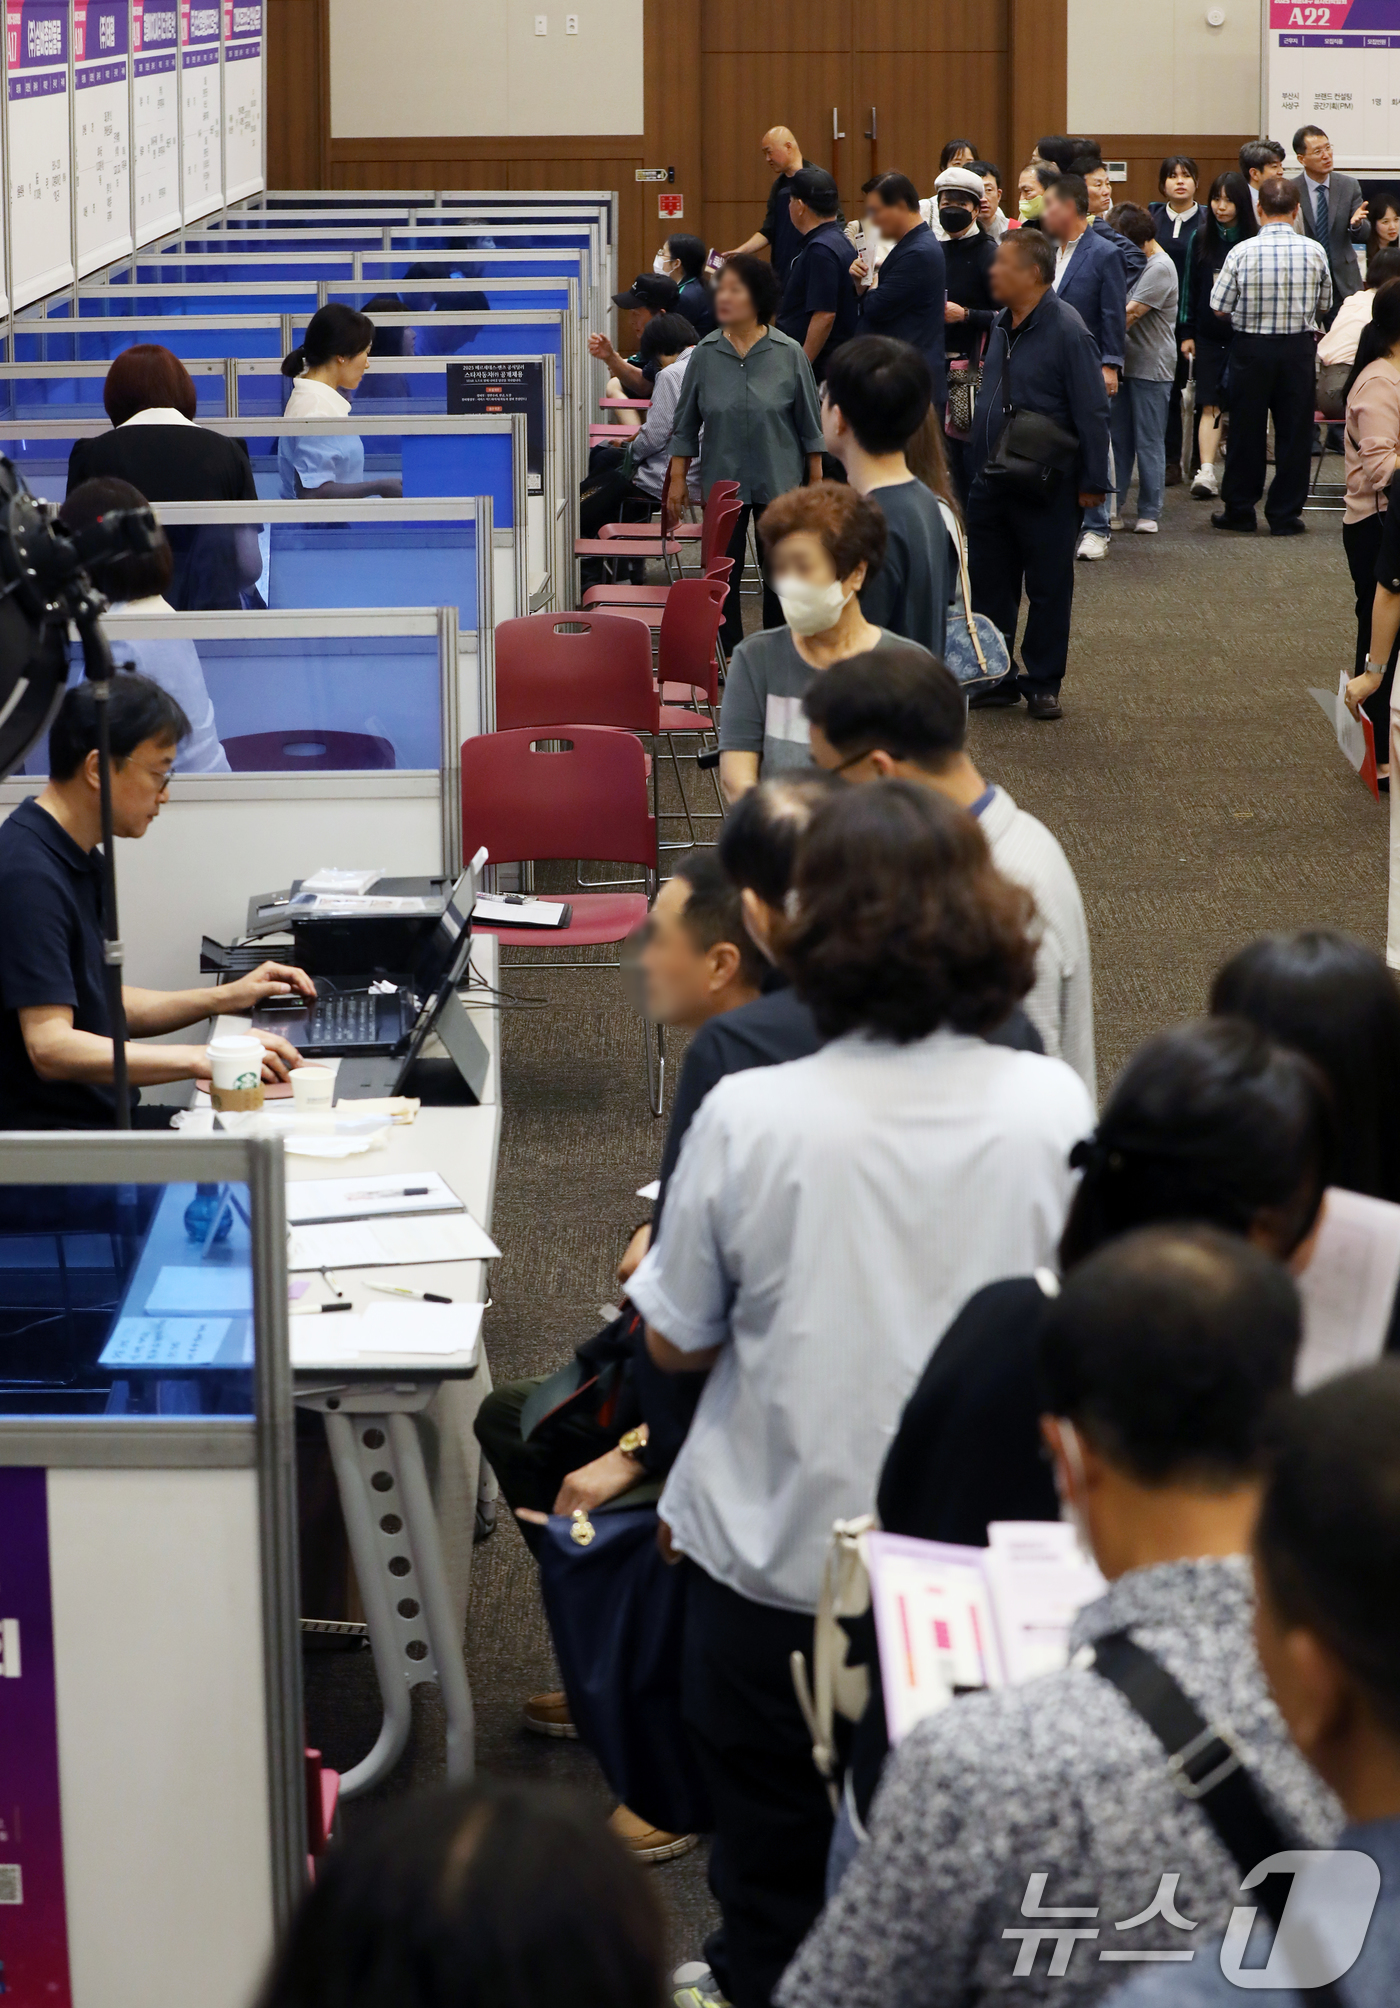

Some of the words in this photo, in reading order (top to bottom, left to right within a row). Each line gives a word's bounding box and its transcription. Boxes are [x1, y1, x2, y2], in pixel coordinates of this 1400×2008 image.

[1288, 7, 1330, 26] A22
[1283, 37, 1298, 45] 근무지
[1282, 92, 1299, 100] 부산시
[1314, 92, 1333, 101] 브랜드
[1334, 92, 1353, 101] 컨설팅
[1281, 101, 1300, 110] 사상구
[1313, 101, 1354, 110] 공간기획(PM)
[1371, 98, 1382, 106] 1명
